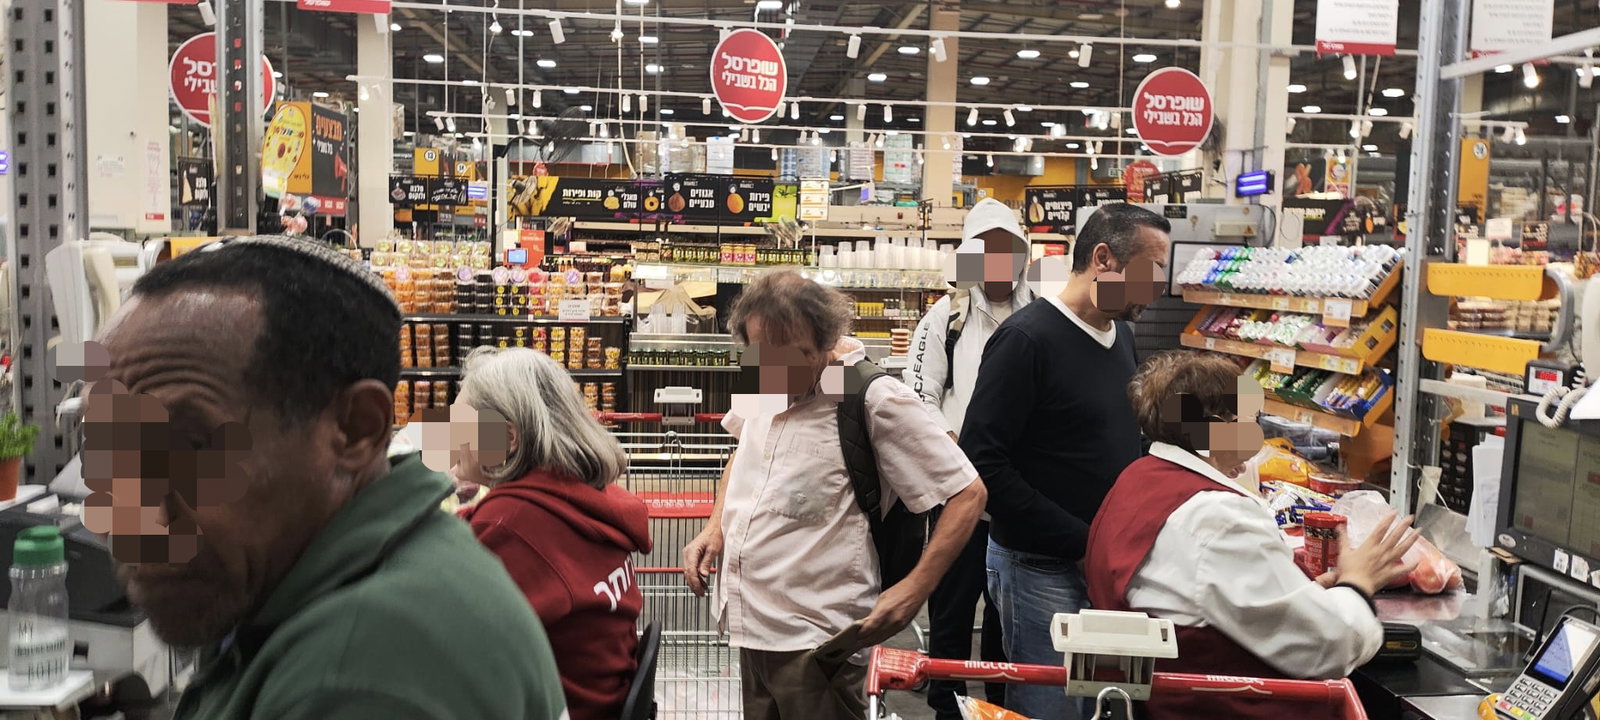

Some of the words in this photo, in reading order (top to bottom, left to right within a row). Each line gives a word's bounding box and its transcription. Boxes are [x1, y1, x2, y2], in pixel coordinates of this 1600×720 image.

[721, 51, 779, 76] שופרסל
[721, 70, 757, 89] בשבילי
[757, 75, 777, 92] הכל
[1143, 91, 1205, 111] שופרסל
[1143, 108, 1181, 126] בשבילי
[1182, 110, 1204, 127] הכל
[562, 188, 586, 199] ופירות
[690, 188, 714, 198] אגוזים
[749, 192, 770, 202] פירות
[689, 199, 715, 208] טבעיים
[748, 202, 771, 212] יבשים
